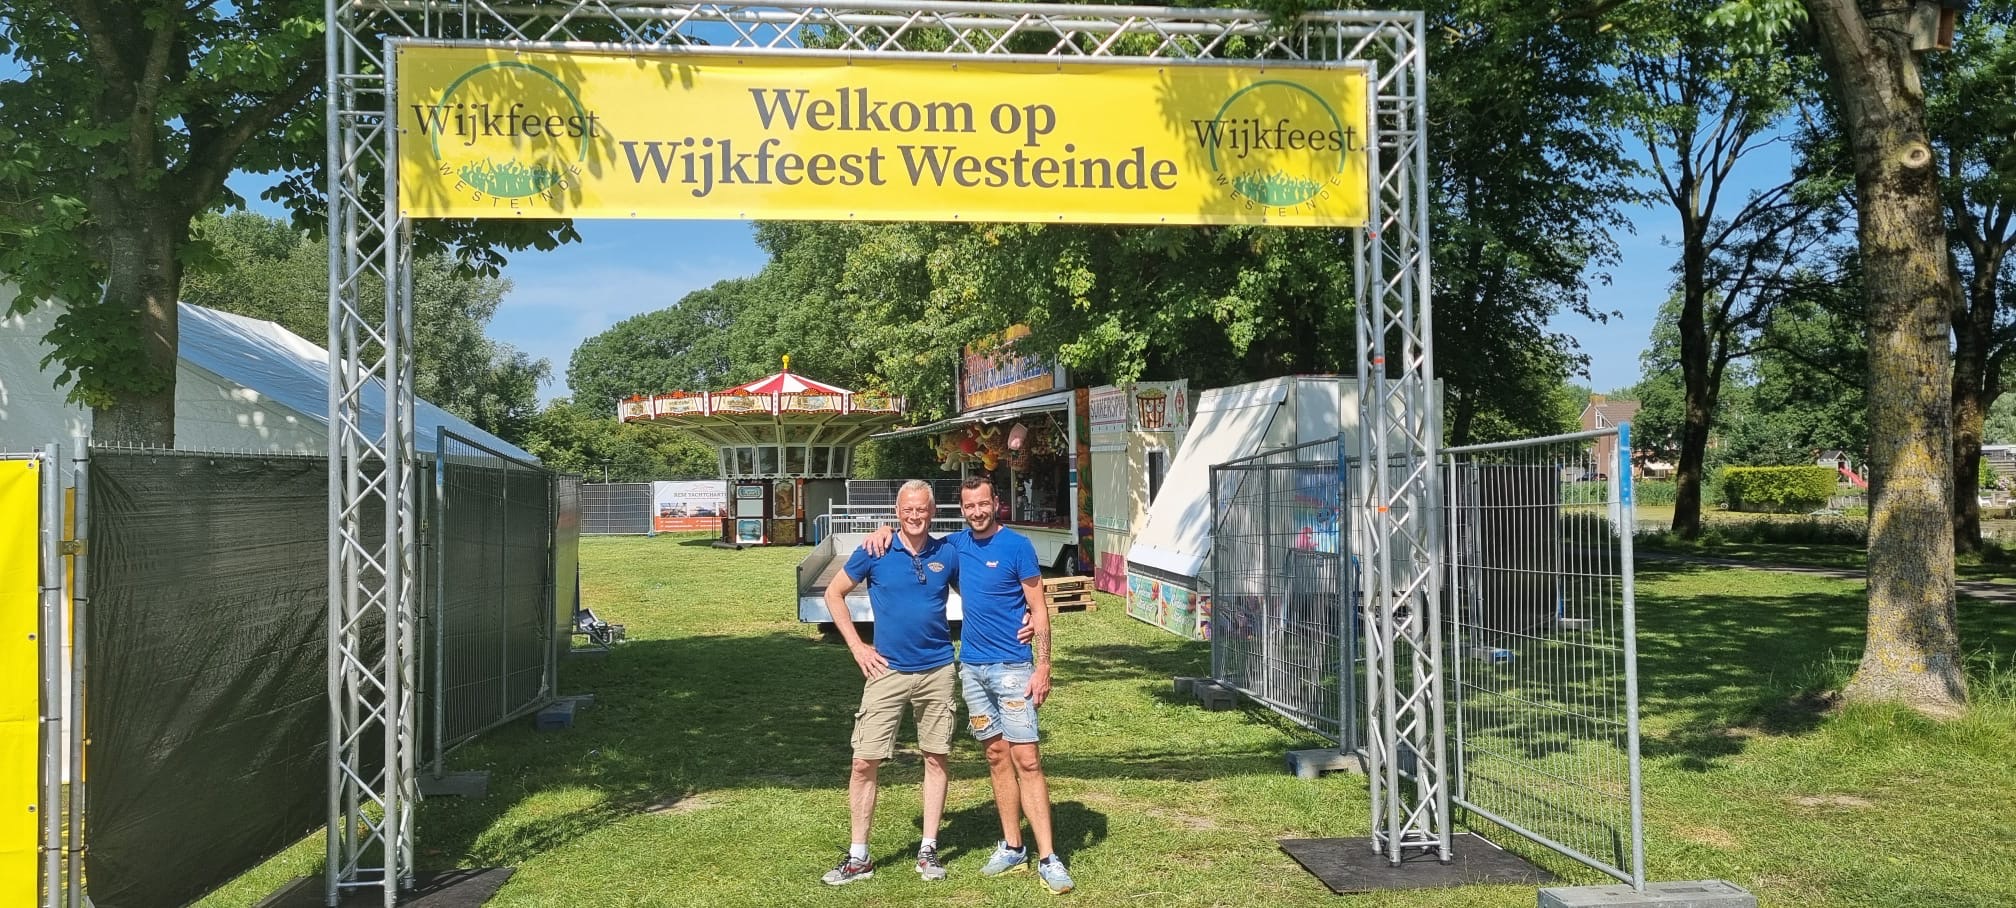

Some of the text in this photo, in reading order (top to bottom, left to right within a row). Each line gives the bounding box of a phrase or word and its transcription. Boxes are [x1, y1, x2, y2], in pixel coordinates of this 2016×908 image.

[411, 103, 600, 146] Wijkfeest
[748, 87, 1056, 147] Welkom op
[1190, 118, 1357, 159] Wijkfeest
[439, 162, 583, 209] WESTEINDE
[619, 137, 1178, 197] Wijkfeest Westeinde
[1216, 173, 1341, 217] WESTEINDE
